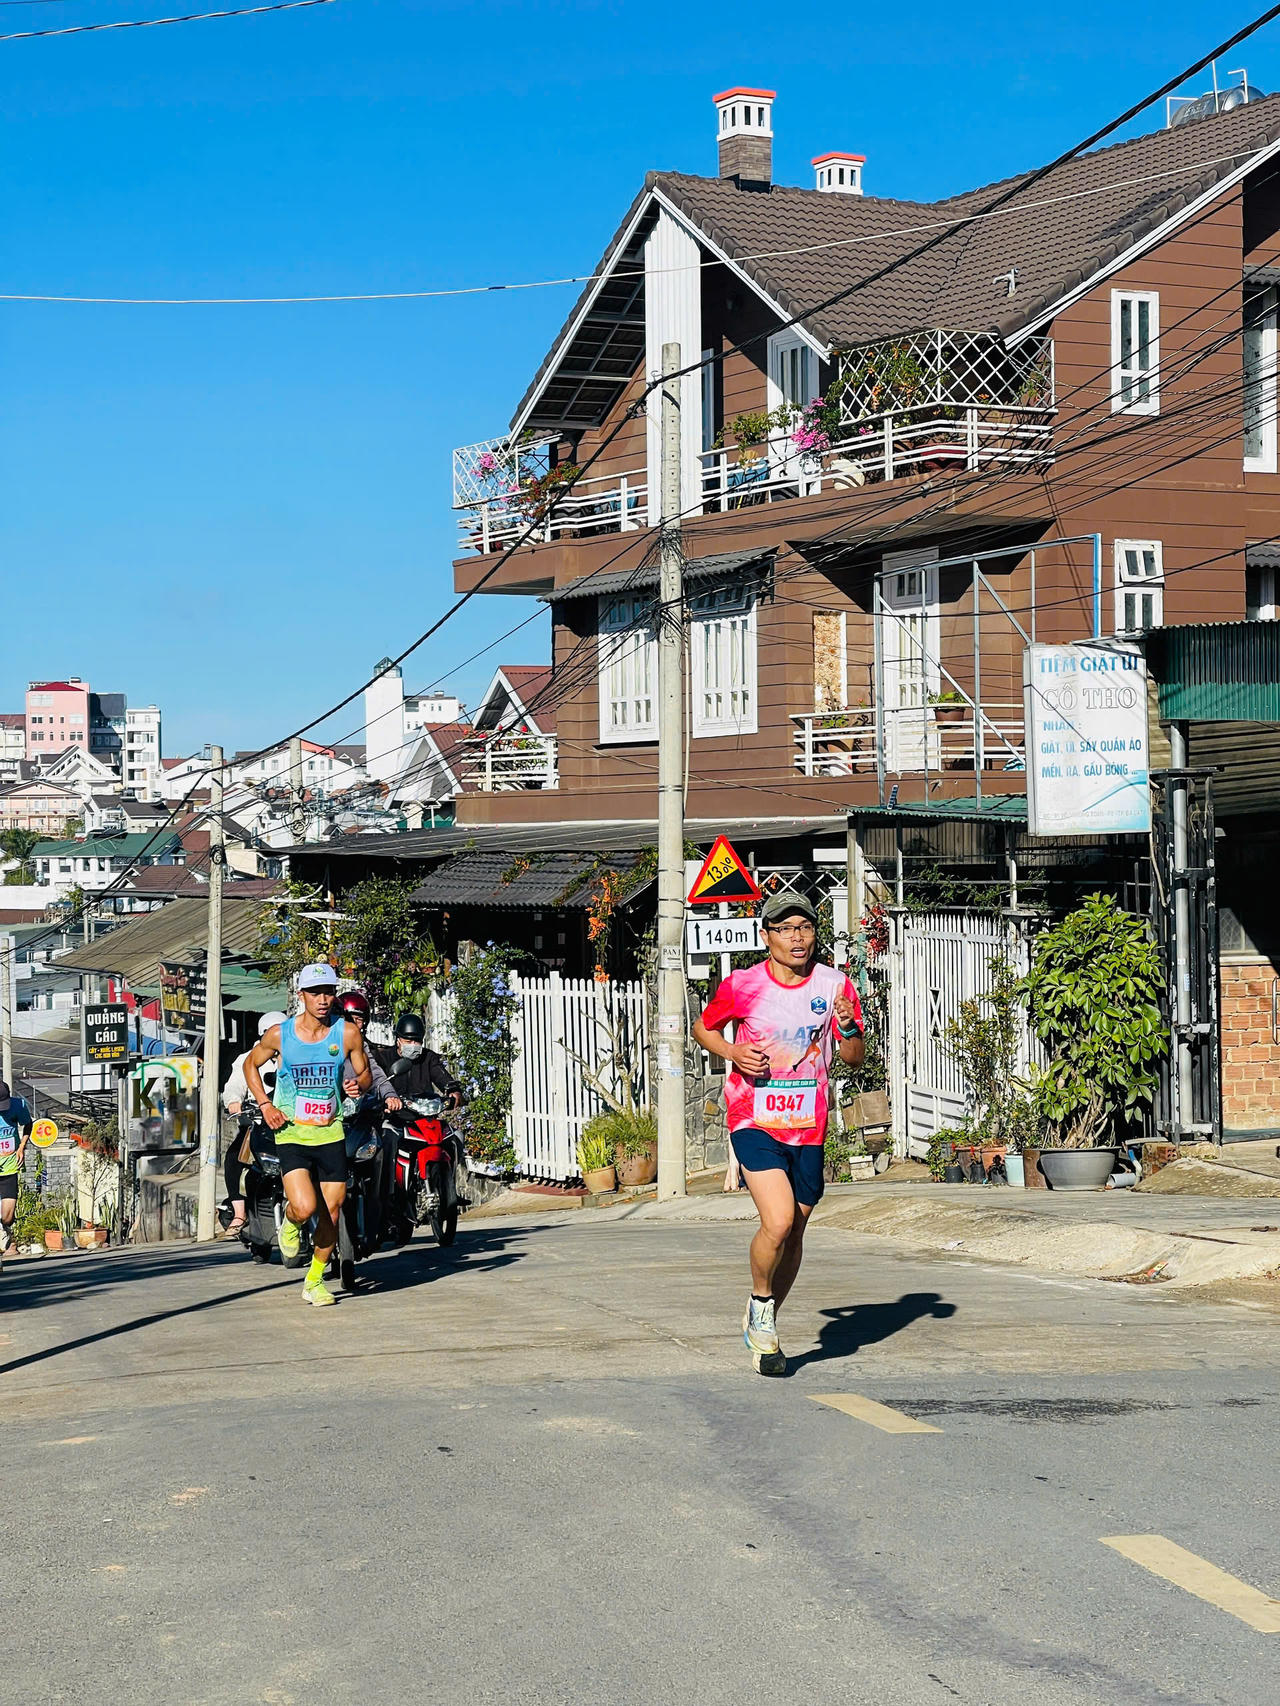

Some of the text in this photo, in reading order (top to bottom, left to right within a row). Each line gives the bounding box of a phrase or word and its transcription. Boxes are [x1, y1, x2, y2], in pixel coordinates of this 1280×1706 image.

[1080, 653, 1118, 675] GIẶT
[1042, 683, 1138, 711] CÔ THO
[706, 856, 735, 883] 13%
[86, 1008, 125, 1026] QUẢNG
[95, 1026, 118, 1043] CÁO
[304, 1102, 332, 1115] 0255
[766, 1093, 805, 1112] 0347
